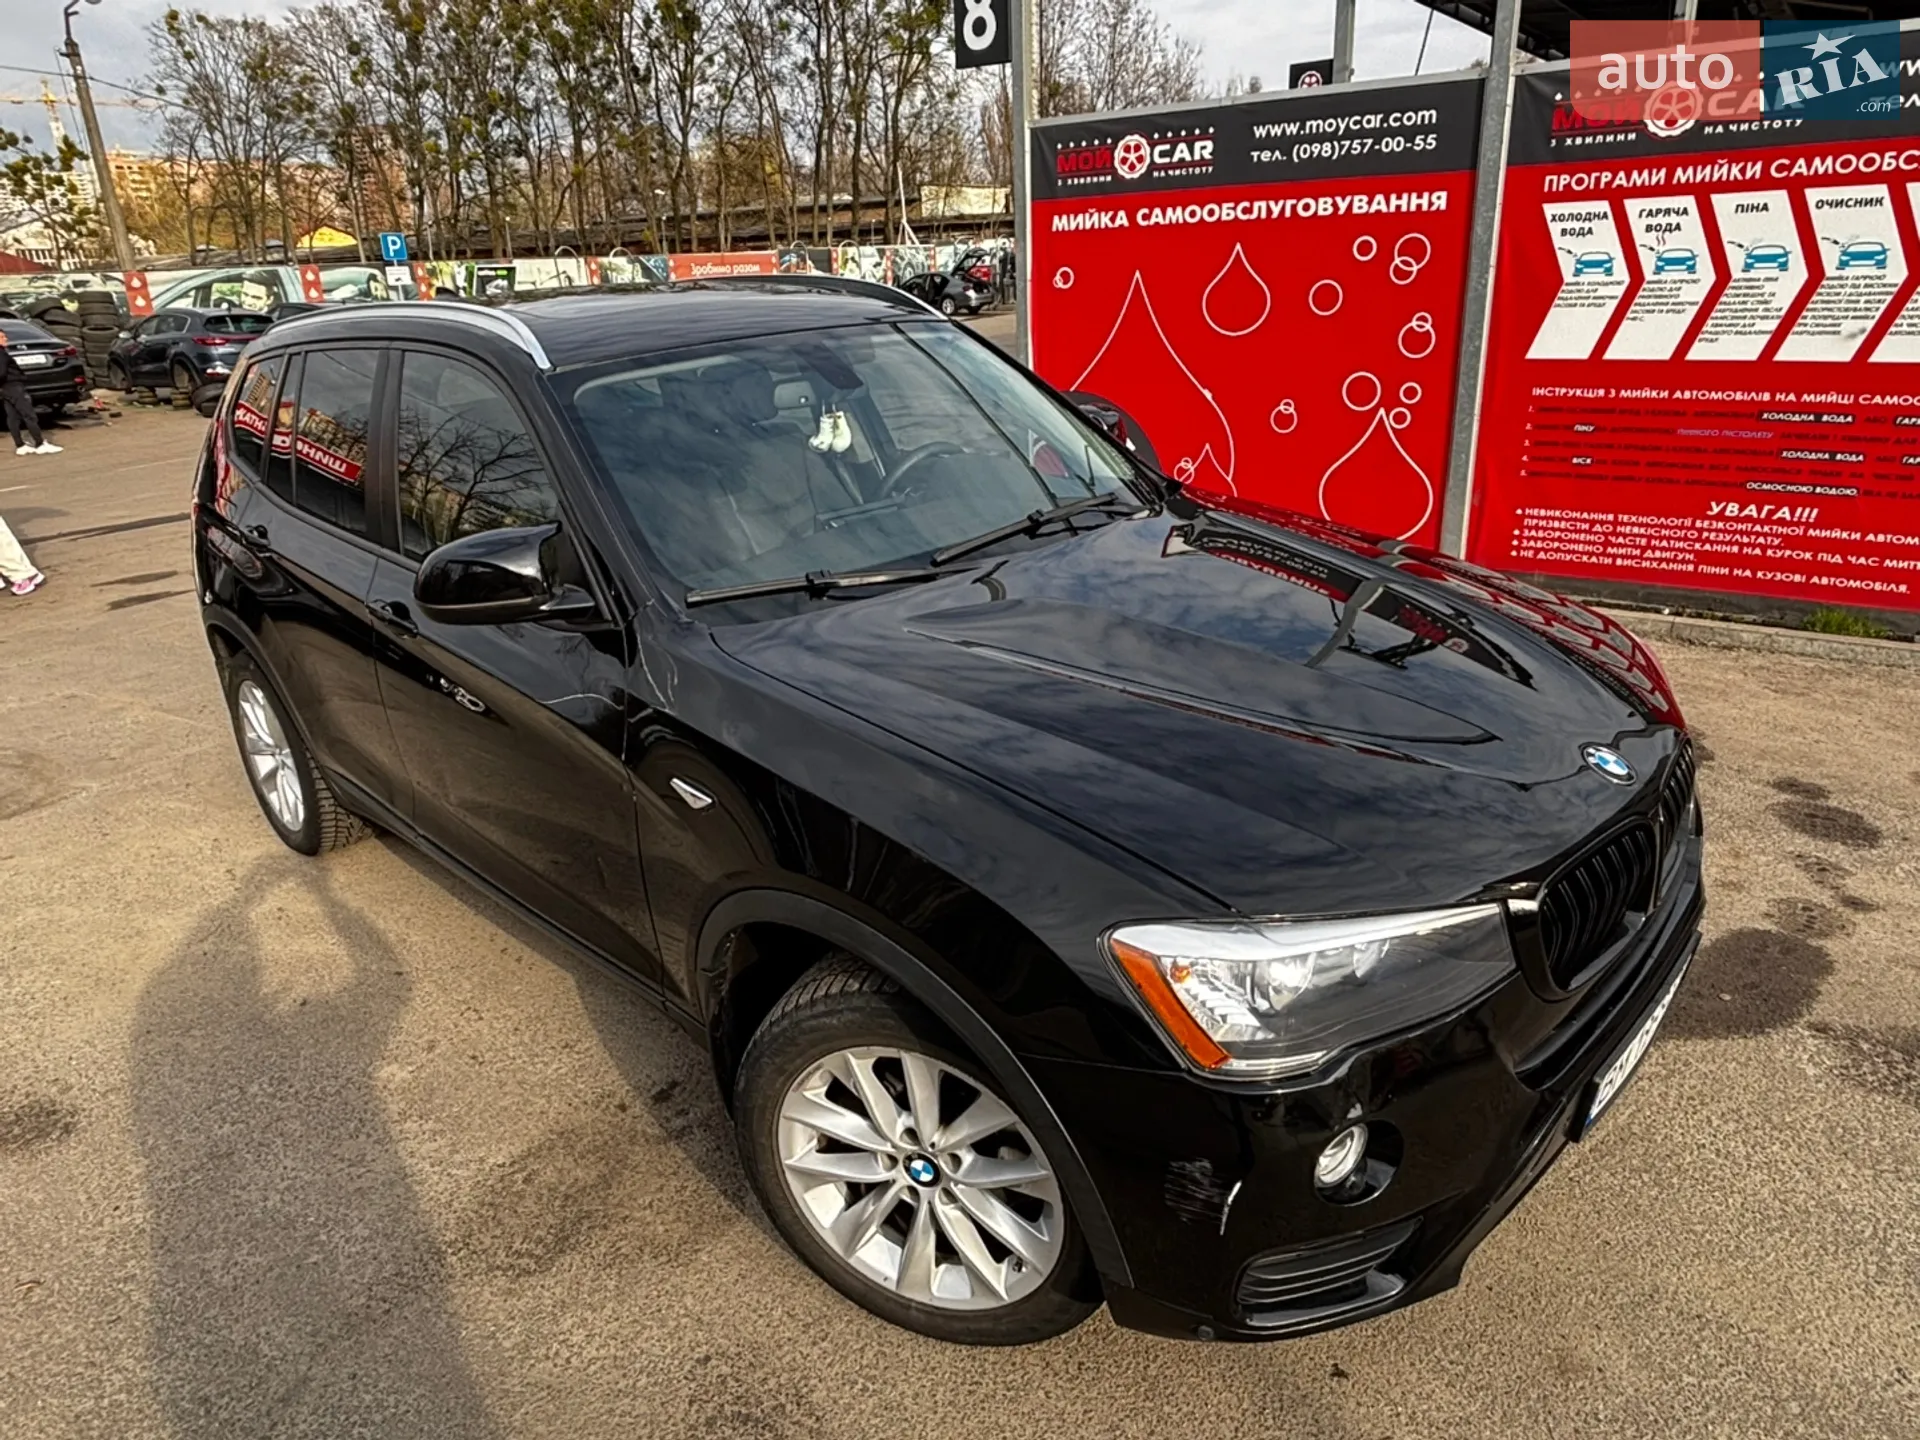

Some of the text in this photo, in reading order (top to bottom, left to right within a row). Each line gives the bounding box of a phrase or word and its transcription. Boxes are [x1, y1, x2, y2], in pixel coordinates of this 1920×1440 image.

[963, 0, 997, 51] 8
[1253, 109, 1437, 139] www.moycar.com
[1564, 132, 1637, 146] ХВИЛИНИ
[1704, 123, 1724, 135] НА
[1729, 118, 1804, 132] ЧИСТОТУ
[1057, 140, 1213, 172] МОЙ CAR
[1251, 134, 1437, 162] тел. (098)757-00-55
[1168, 166, 1214, 177] ЧИСТОТУ
[1543, 149, 1920, 193] ПРОГРАМИ МИЙКИ САМООБС
[1051, 191, 1448, 232] МИЙКА САМООБСЛУГОВУВАННЯ
[1638, 206, 1690, 219] ГАРЯЧА
[1735, 202, 1770, 214] ПІНА
[1815, 196, 1885, 210] ОЧИСНИК
[1550, 211, 1609, 223] ХОЛОДНА
[1560, 227, 1594, 238] ВОДА
[1645, 222, 1682, 234] ВОДА
[386, 235, 402, 257] P
[690, 262, 760, 277] Зробимо разом
[1532, 387, 1605, 398] ІНСТРУКЦІЯ
[1607, 388, 1616, 398] З
[1619, 387, 1669, 399] МИЙКИ
[1672, 390, 1771, 402] АВТОМОБІЛІВ
[1775, 392, 1797, 402] НА
[1762, 412, 1815, 422] ХОЛОДНА
[1821, 414, 1853, 423] ВОДА
[1782, 451, 1829, 460] ХОЛОДНА
[1835, 453, 1864, 462] ВОДА
[1746, 482, 1813, 493] ОСМОСНОЮ
[1706, 501, 1819, 522] УВАГА!!!
[1523, 519, 1784, 547] ПРИЗВЕСТИ ДО НЕЯКІСНОГО РЕЗУЛЬТАТУ.
[1525, 508, 1614, 521] НЕВИКОНАННЯ
[1617, 514, 1692, 527] ТЕХНОЛОГІЇ
[1695, 519, 1804, 536] БЕЗКОНТАКТНОЇ
[1807, 528, 1861, 541] МИЙКИ
[1520, 540, 1697, 562] ЗАБОРОНЕНО МИТИ ДВИГУН.
[1522, 529, 1605, 543] ЗАБОРОНЕНО
[1608, 536, 1647, 547] ЧАСТЕ
[1651, 539, 1739, 554] НАТИСКАННЯ
[1743, 547, 1762, 556] НА
[1766, 549, 1813, 561] КУРОК
[1817, 553, 1843, 564] ПІД
[1847, 555, 1880, 567] ЧАС
[1520, 549, 1910, 595] НЕ ДОПУСКАТИ ВИСИХАННЯ ПІНИ НА КУЗОВІ АВТОМОБІЛЯ.
